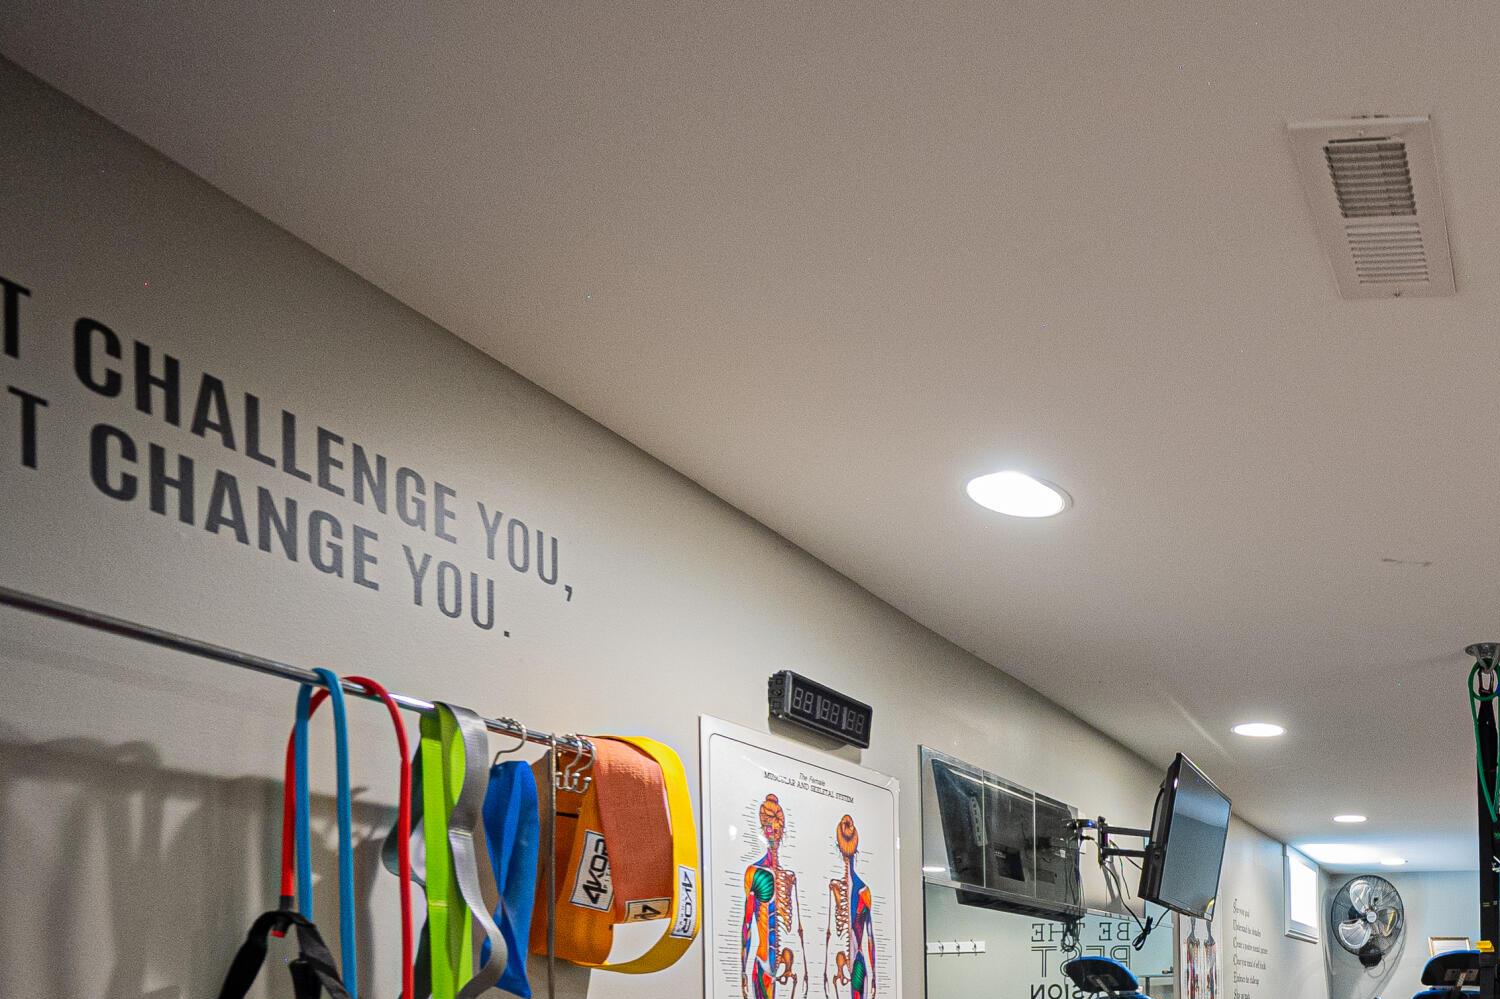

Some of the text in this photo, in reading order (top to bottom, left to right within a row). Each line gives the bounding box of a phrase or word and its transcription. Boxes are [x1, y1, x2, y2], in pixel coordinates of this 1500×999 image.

[73, 316, 459, 546] CHALLENGE
[476, 500, 575, 603] YOU,
[89, 422, 380, 592] CHANGE
[402, 543, 512, 639] YOU.
[797, 780, 810, 791] AND
